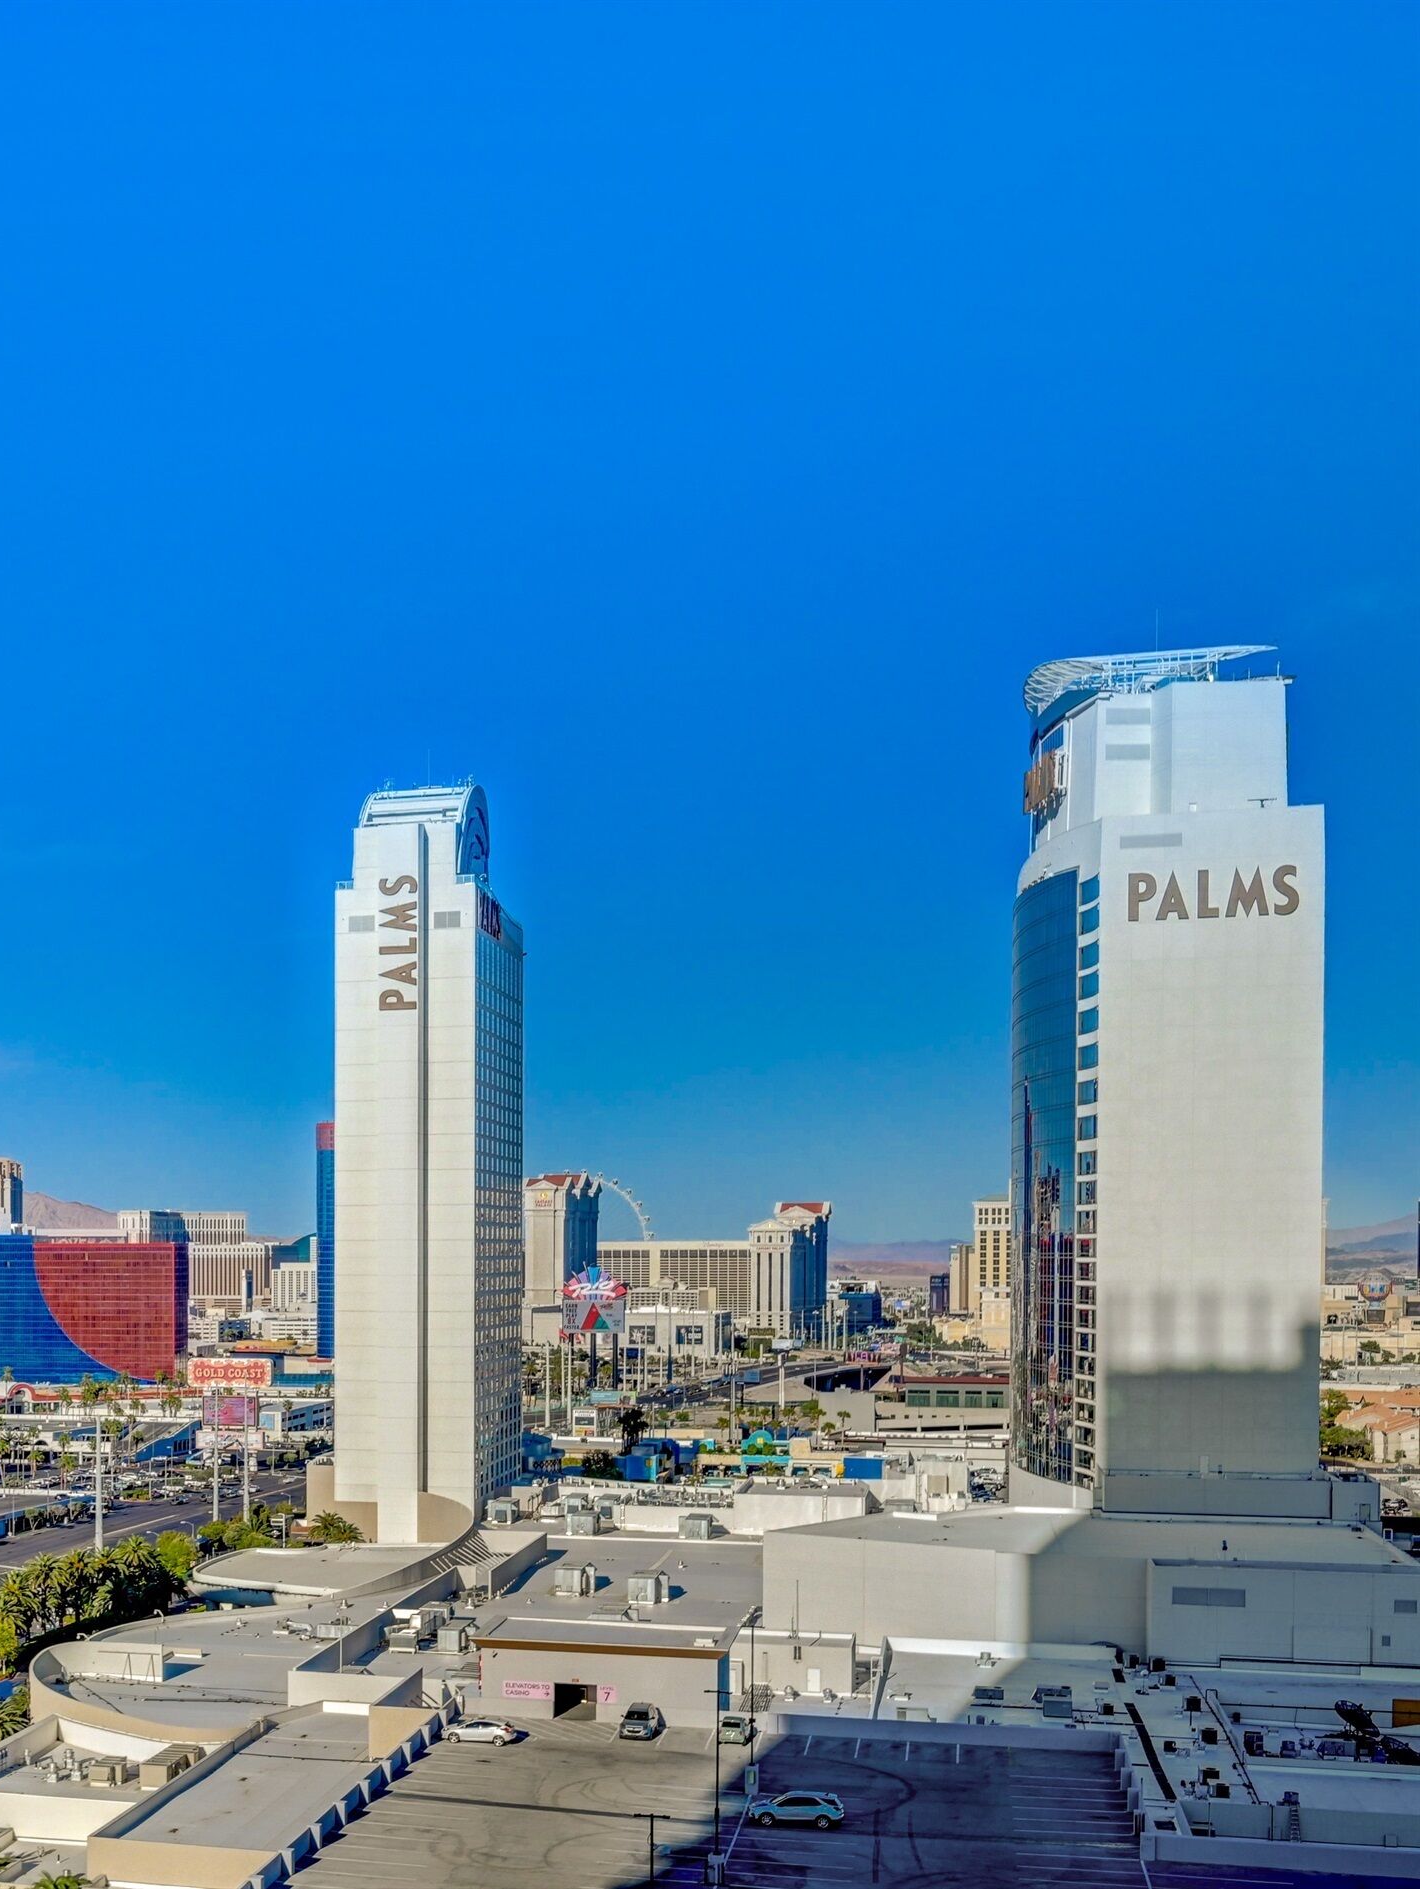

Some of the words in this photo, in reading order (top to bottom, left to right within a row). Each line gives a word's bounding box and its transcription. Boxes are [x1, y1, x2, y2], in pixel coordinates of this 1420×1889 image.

[1127, 864, 1300, 922] PALMS
[378, 874, 418, 1011] PALMS
[195, 1368, 224, 1378] GOLD
[227, 1368, 263, 1378] COAST
[505, 1682, 540, 1690] ELEVATORS
[604, 1691, 610, 1701] 7
